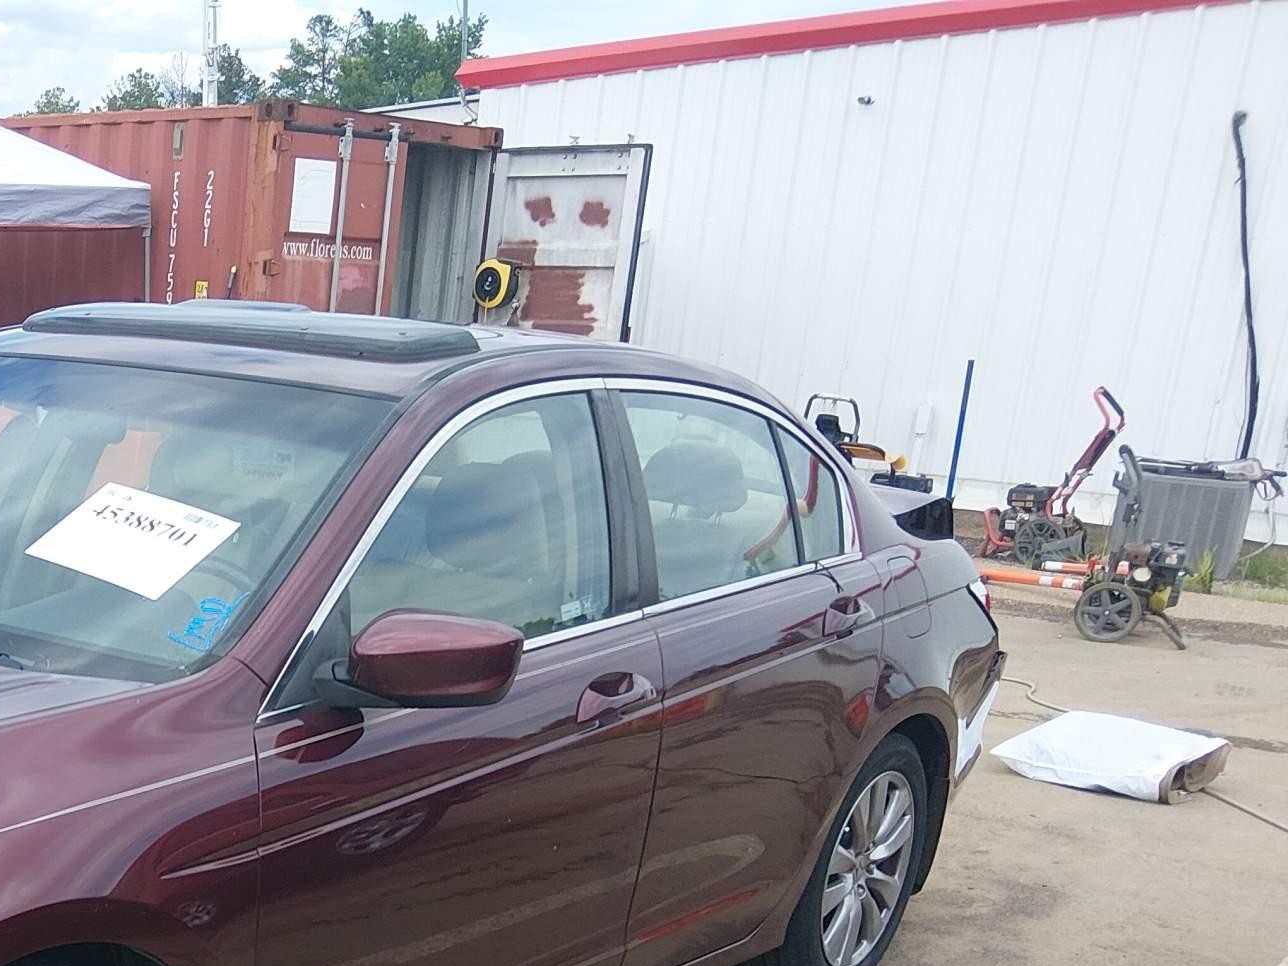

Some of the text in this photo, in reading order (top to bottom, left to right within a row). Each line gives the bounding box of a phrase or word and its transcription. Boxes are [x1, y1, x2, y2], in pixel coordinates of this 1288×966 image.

[166, 171, 180, 304] FSCU 759
[203, 170, 214, 247] 22G1
[92, 504, 198, 546] 45388701
